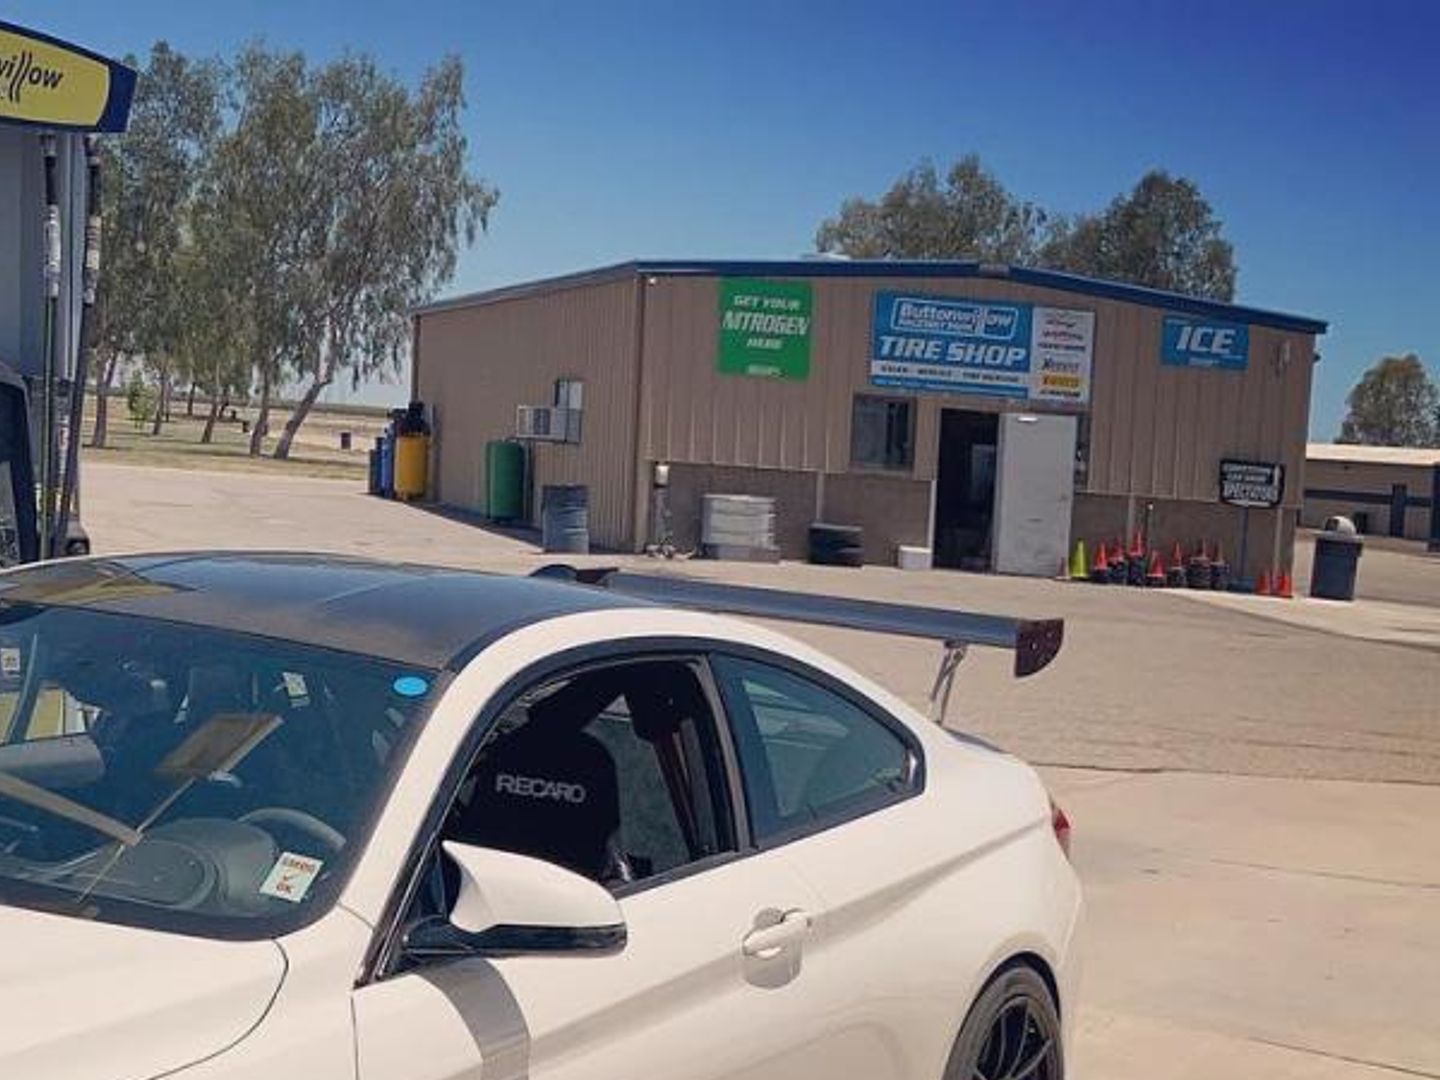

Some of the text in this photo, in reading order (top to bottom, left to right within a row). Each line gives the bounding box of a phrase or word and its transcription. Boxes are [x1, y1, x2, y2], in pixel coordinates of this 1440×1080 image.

[722, 310, 810, 335] NITROGEN
[898, 301, 1012, 338] Buttonwillow
[879, 335, 943, 360] TIRE
[946, 342, 1027, 367] SHOP
[1175, 326, 1237, 354] ICE
[496, 773, 586, 803] RECARO
